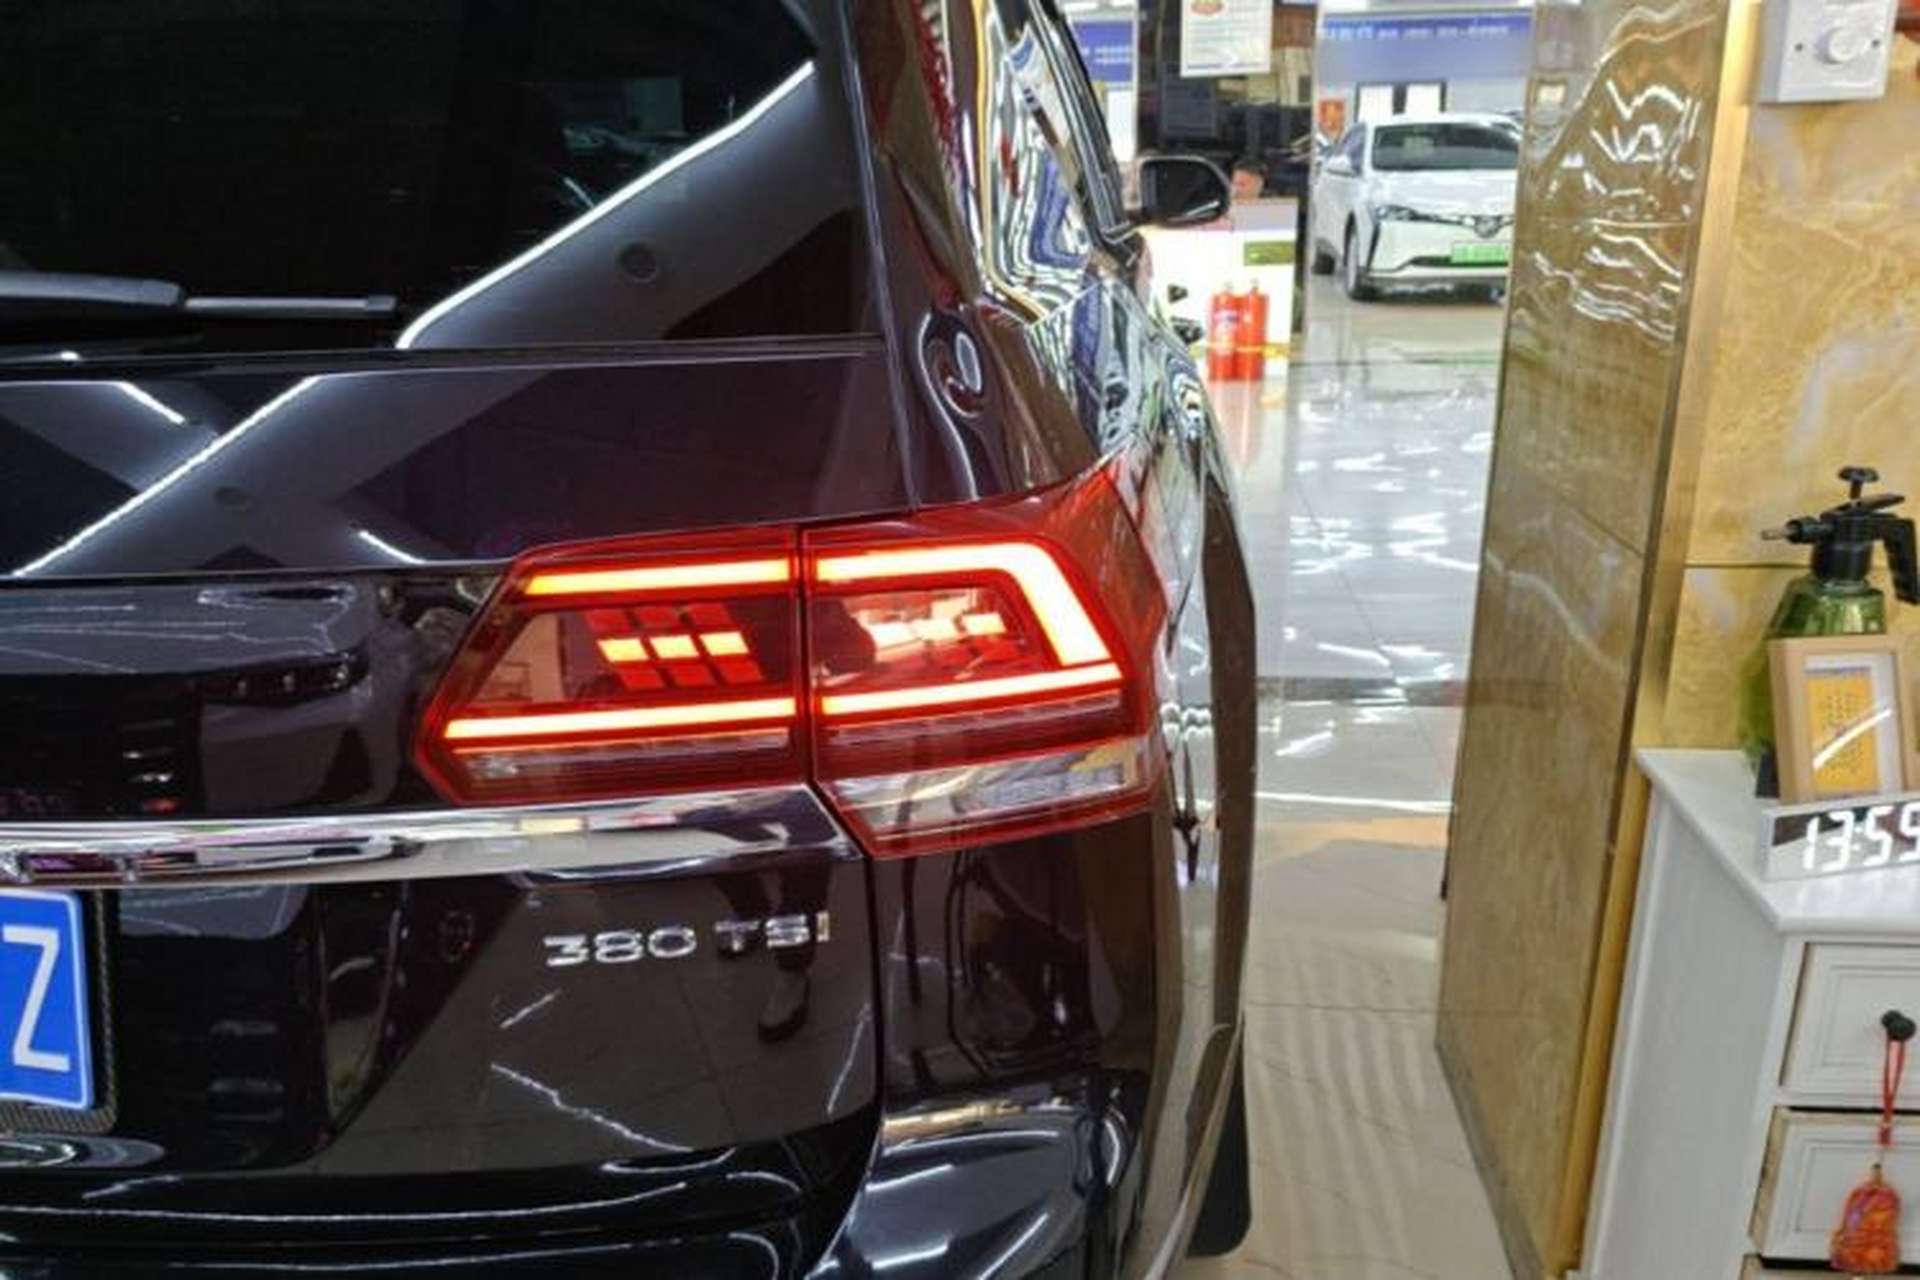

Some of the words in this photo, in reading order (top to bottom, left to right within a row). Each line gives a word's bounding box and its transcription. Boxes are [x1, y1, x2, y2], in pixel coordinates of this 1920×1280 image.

[543, 926, 697, 966] 380
[714, 910, 830, 951] TSI
[2, 924, 71, 1072] Z
